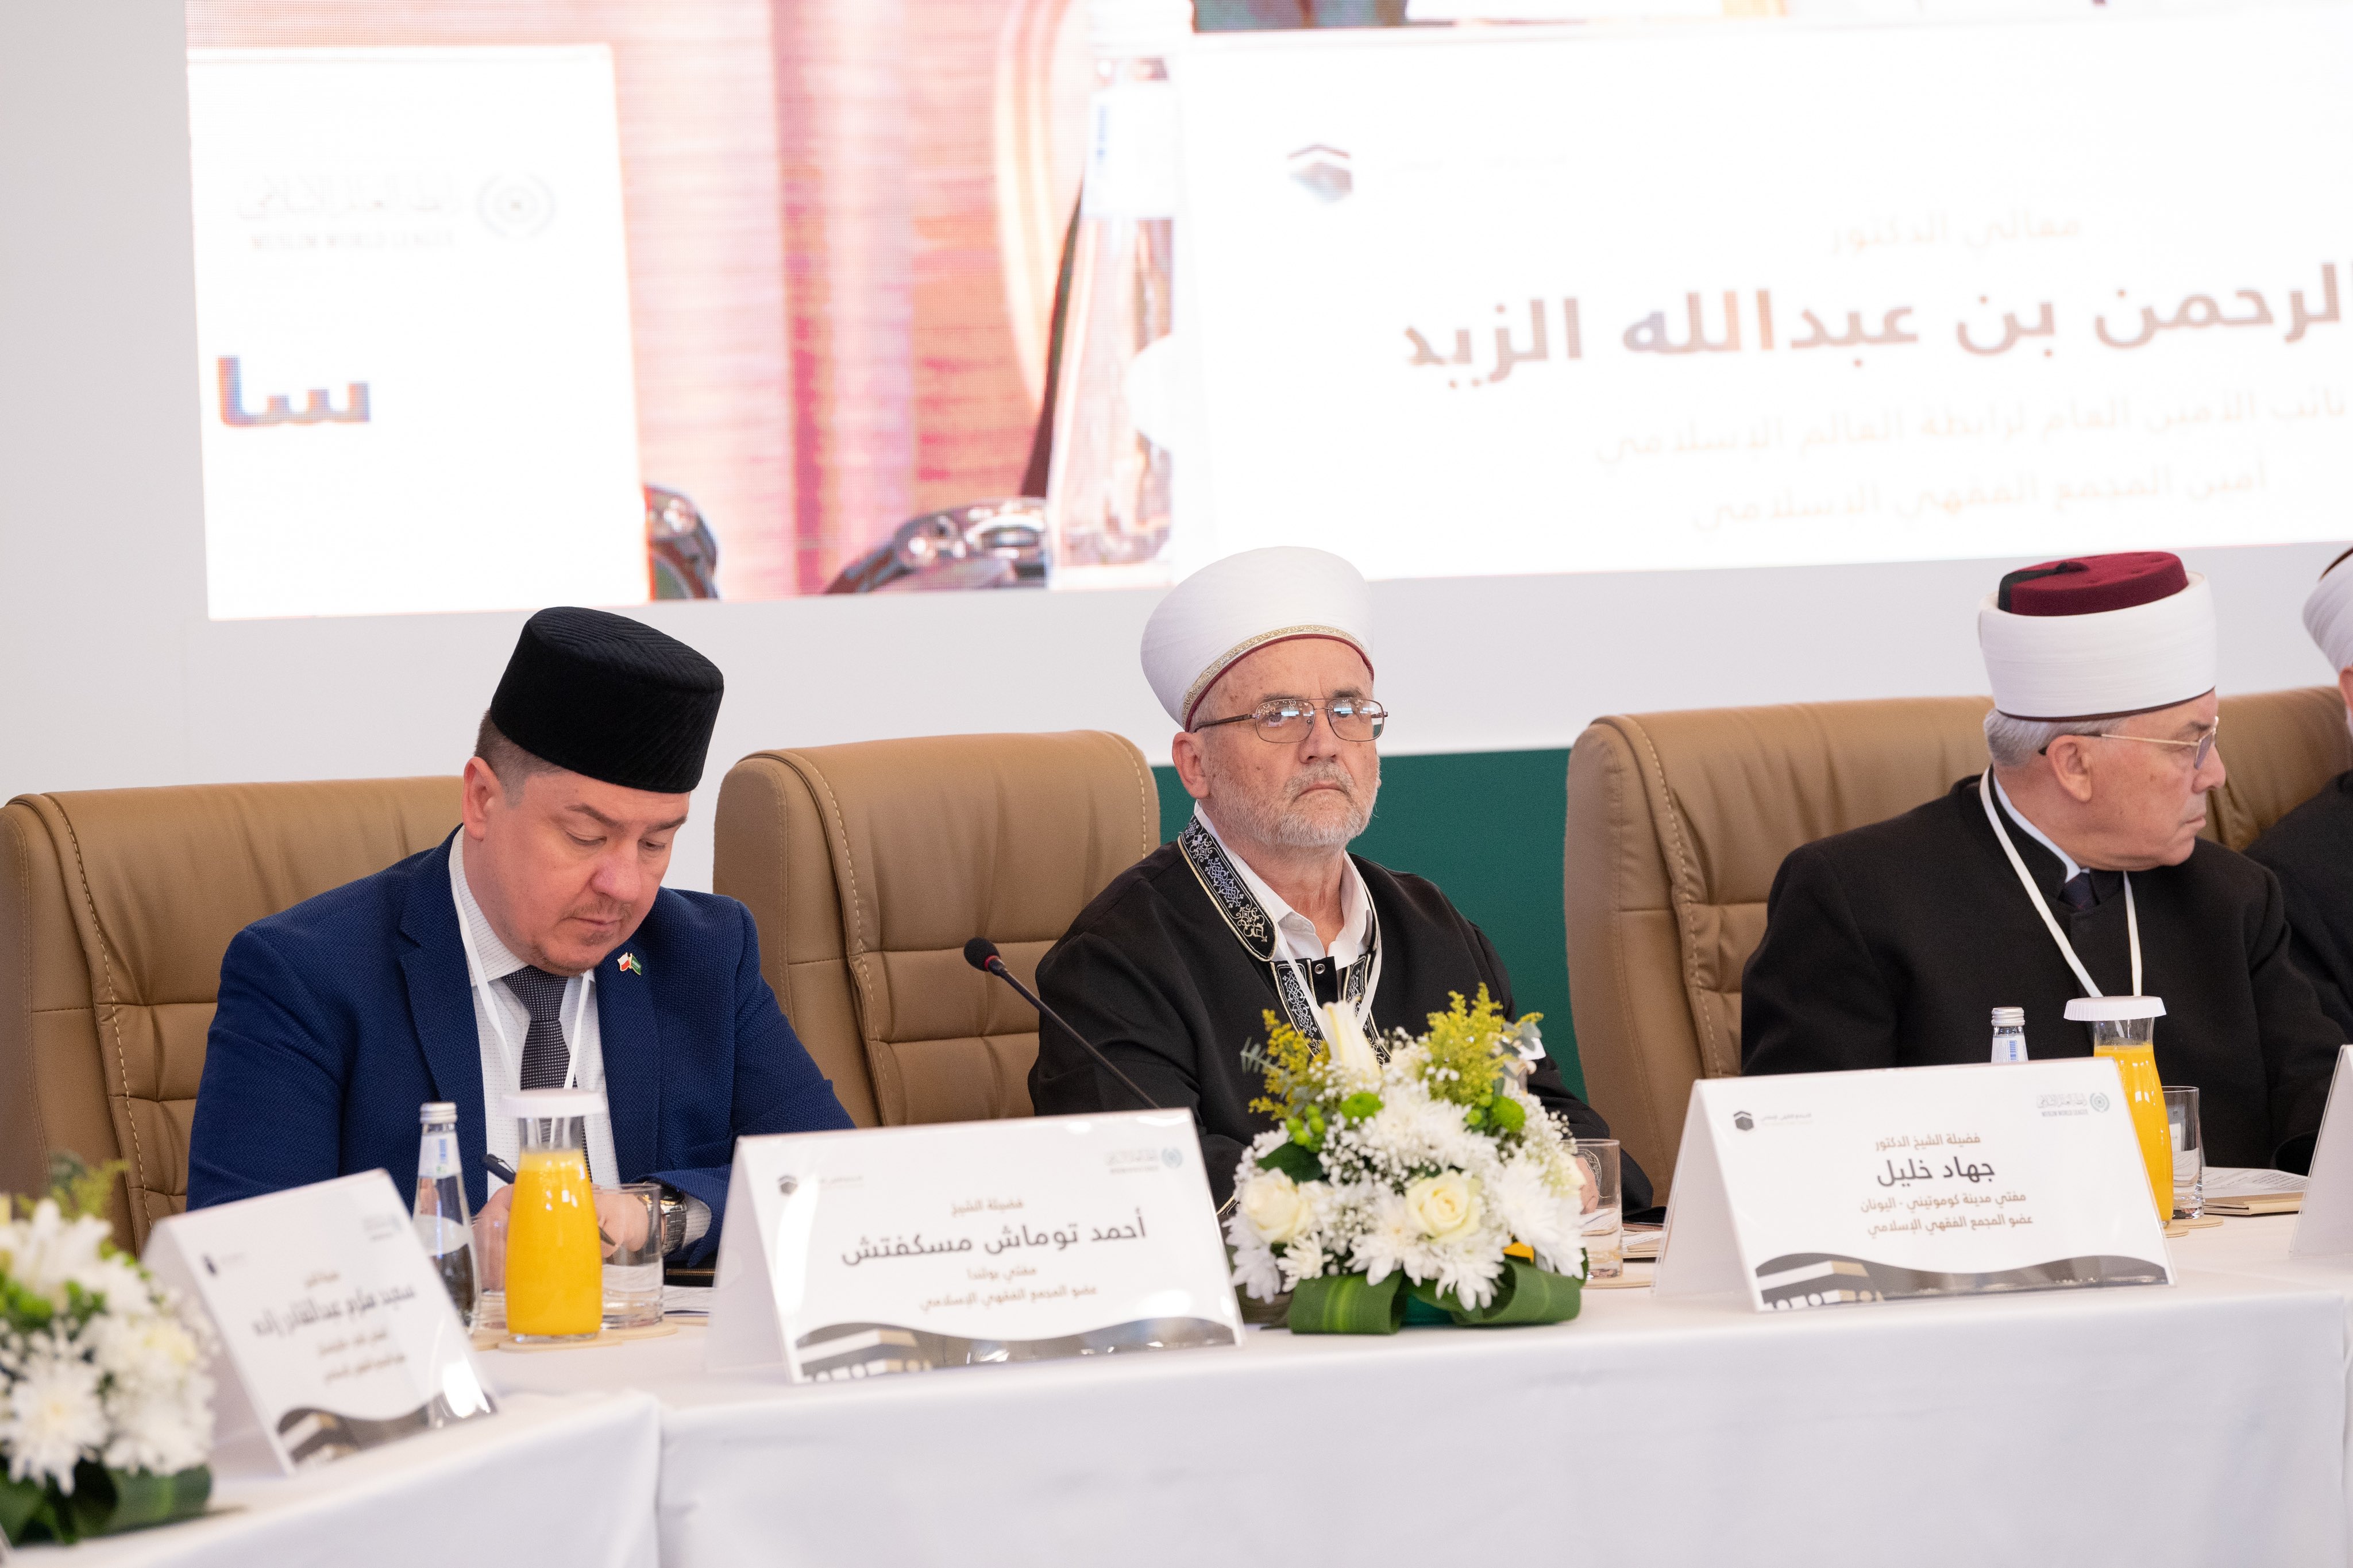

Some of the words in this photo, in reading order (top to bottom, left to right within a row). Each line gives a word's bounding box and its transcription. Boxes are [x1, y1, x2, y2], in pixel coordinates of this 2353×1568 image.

[1829, 211, 1949, 258] الدكتور
[2092, 260, 2353, 352] لرحمن
[1955, 292, 2057, 360] بن
[1405, 295, 1584, 390] الزيد
[2041, 395, 2131, 442] العام
[1800, 407, 1903, 458] العالم
[2053, 465, 2172, 512] المجمع
[1875, 1136, 1910, 1152] الدكتور
[1914, 1134, 1943, 1150] الشيخ
[1946, 1133, 1981, 1148] فضيلة
[1877, 1158, 1933, 1187] خليل
[1943, 1156, 1996, 1184] جهاد
[951, 1195, 983, 1218] الشيخ
[988, 1195, 1024, 1214] فضيلة
[1861, 1197, 1896, 1213] اليونان
[1906, 1194, 1960, 1213] كوموتيني
[1962, 1192, 1992, 1208] مدينة
[1995, 1191, 2027, 1209] مفتي
[1090, 1208, 1147, 1242] أحمد
[1868, 1218, 1922, 1239] الإسلامي
[1925, 1216, 1968, 1235] الفقهي
[1971, 1214, 2006, 1231] المجمع
[2008, 1213, 2034, 1228] عضو
[842, 1234, 973, 1266] مسكفتش
[984, 1223, 1079, 1254] توماش
